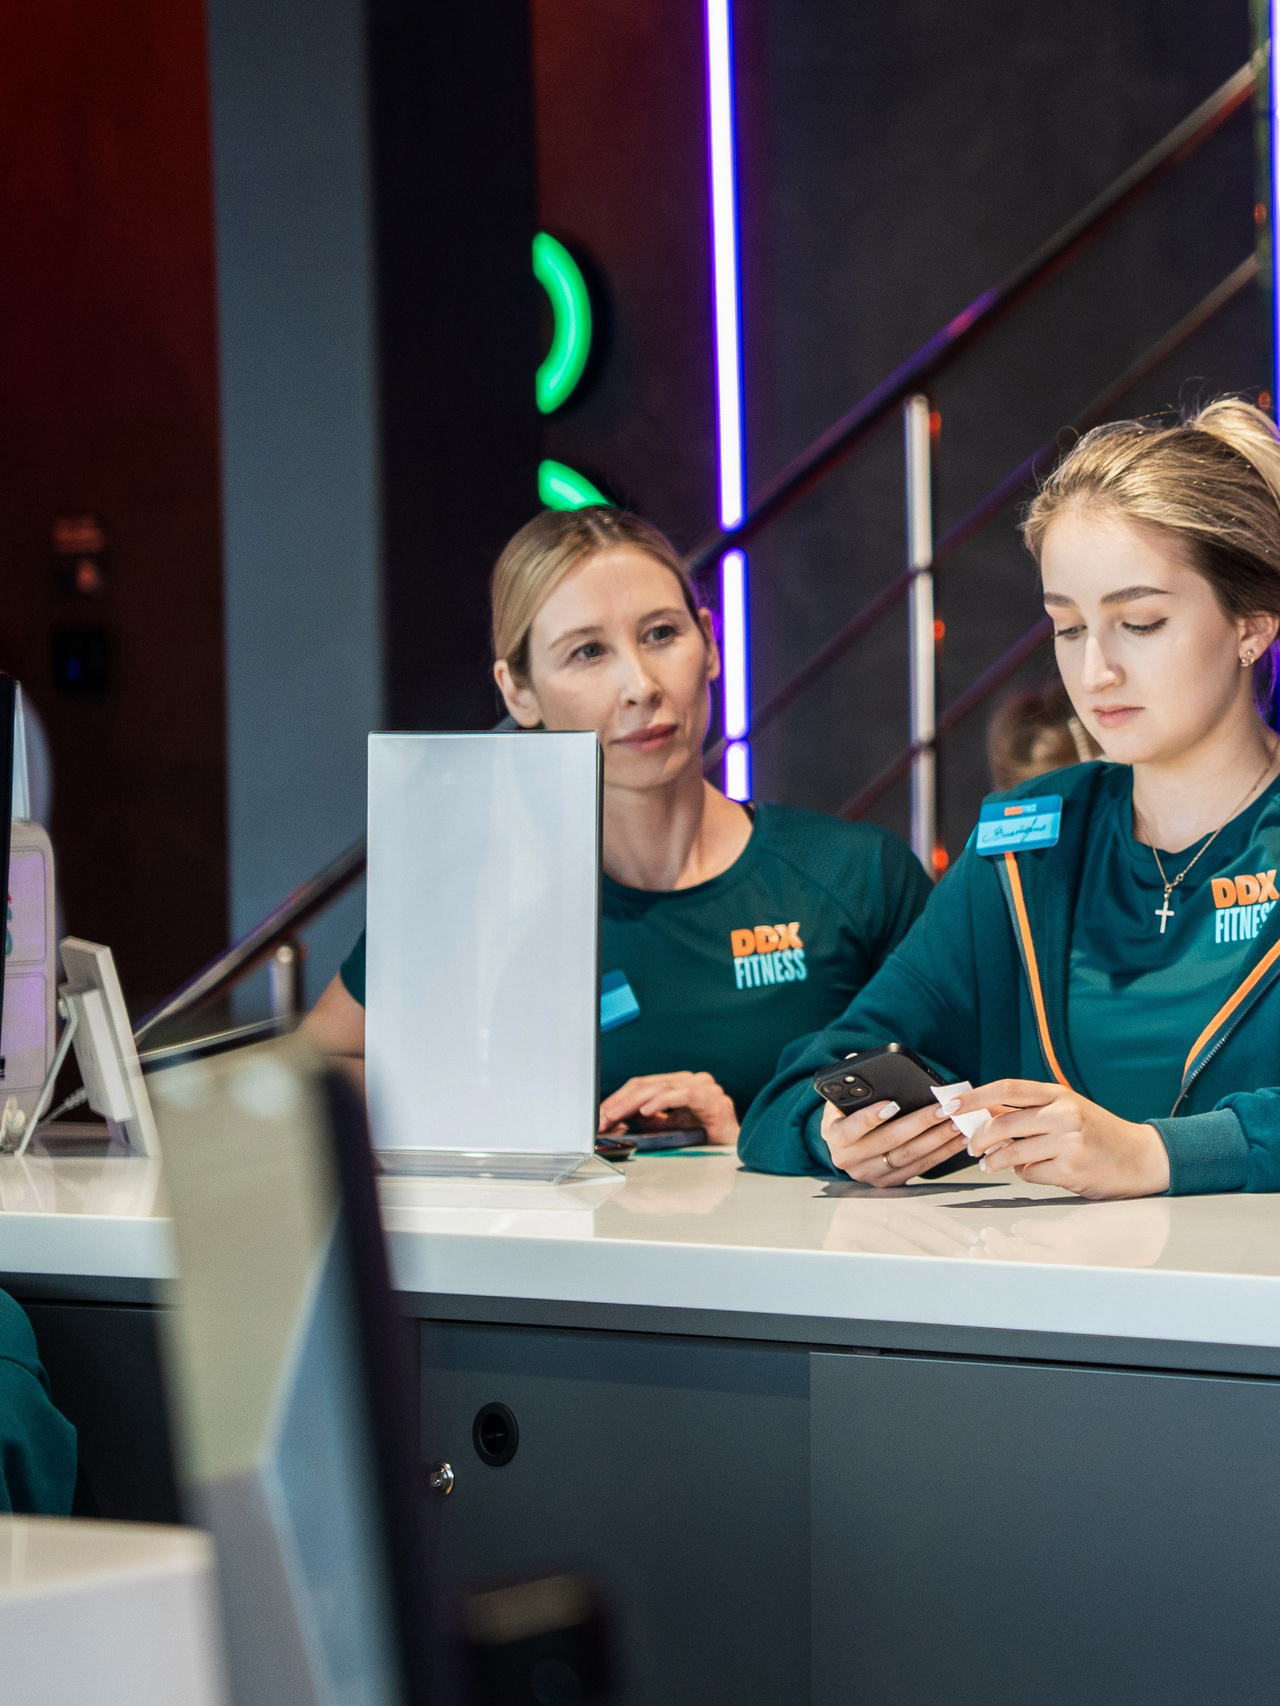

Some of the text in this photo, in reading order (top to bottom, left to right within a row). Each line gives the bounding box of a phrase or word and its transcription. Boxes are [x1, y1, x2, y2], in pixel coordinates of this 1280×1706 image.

[1211, 869, 1280, 908] DDX
[730, 922, 804, 957] DDX
[1215, 900, 1277, 944] FITNES
[733, 947, 807, 990] FITNESS
